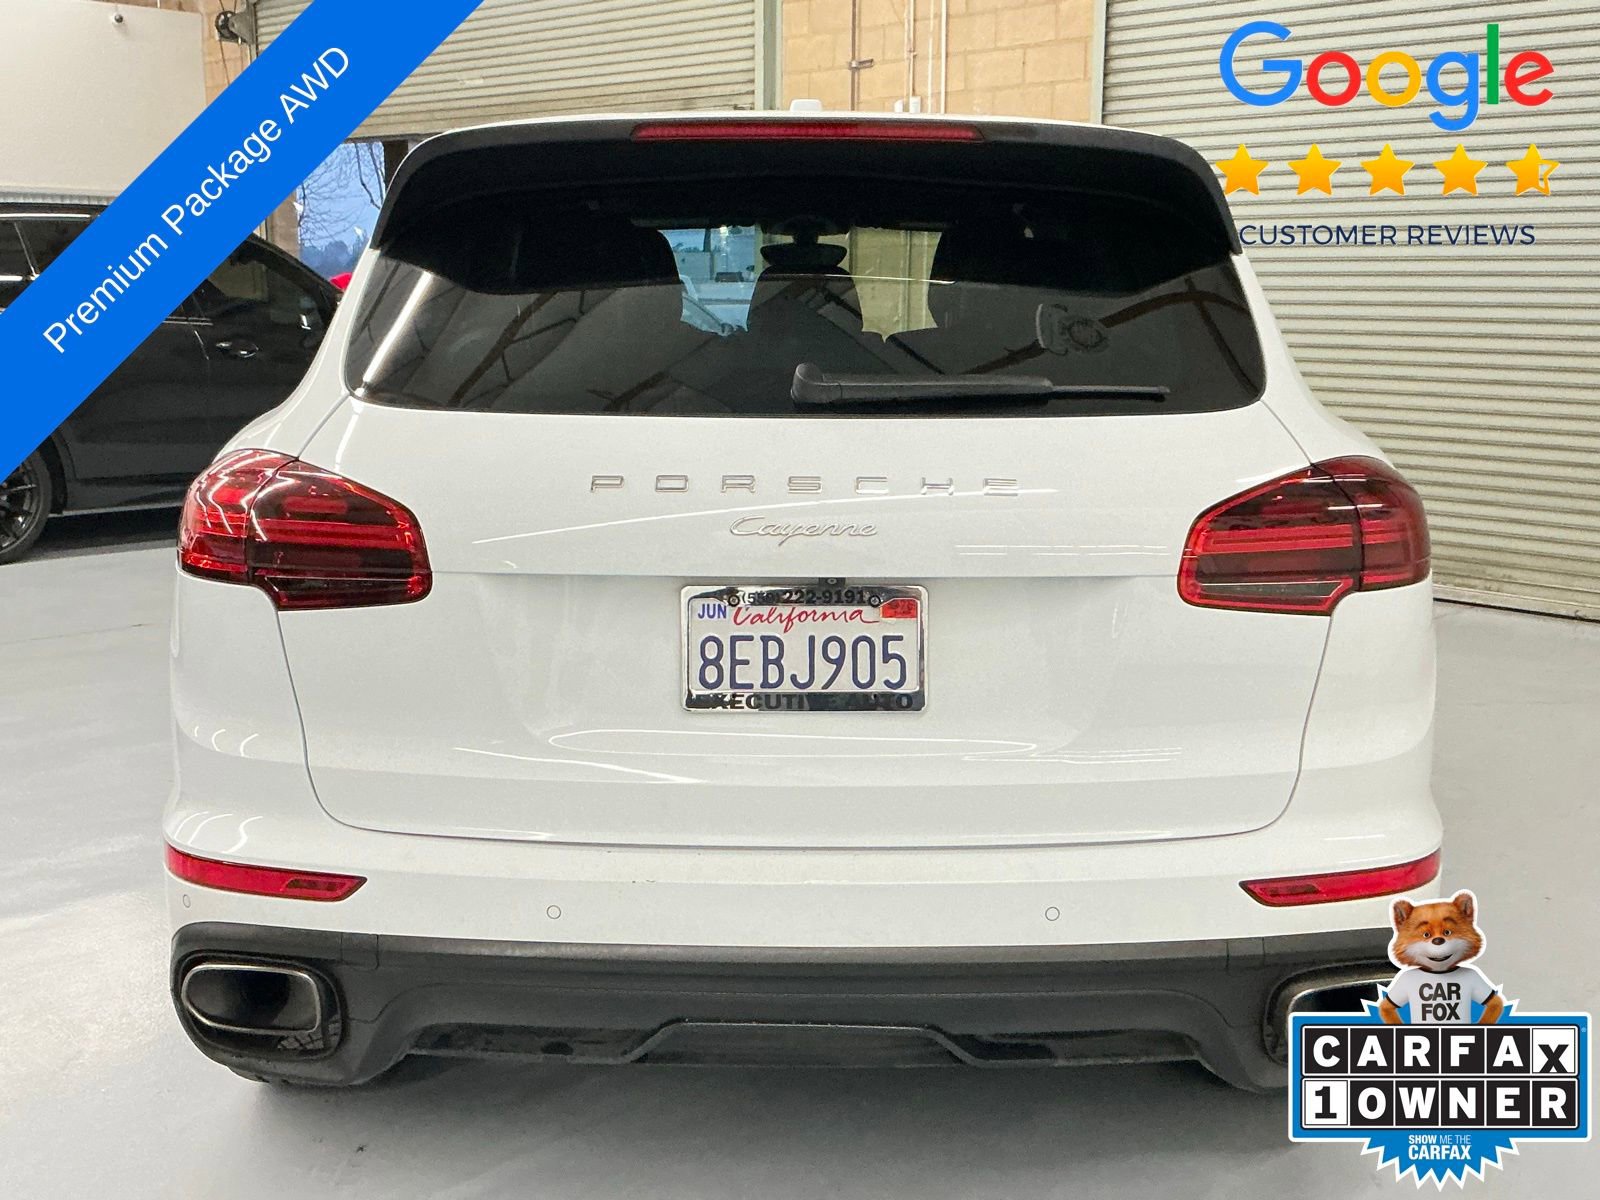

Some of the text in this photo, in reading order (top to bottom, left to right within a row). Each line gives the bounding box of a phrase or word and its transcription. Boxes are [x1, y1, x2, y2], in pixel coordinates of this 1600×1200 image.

[590, 474, 1020, 496] PORSCHE
[729, 515, 879, 547] Cayenne
[697, 603, 728, 620] JUN
[733, 605, 880, 633] California
[698, 634, 908, 690] 8EBJ905
